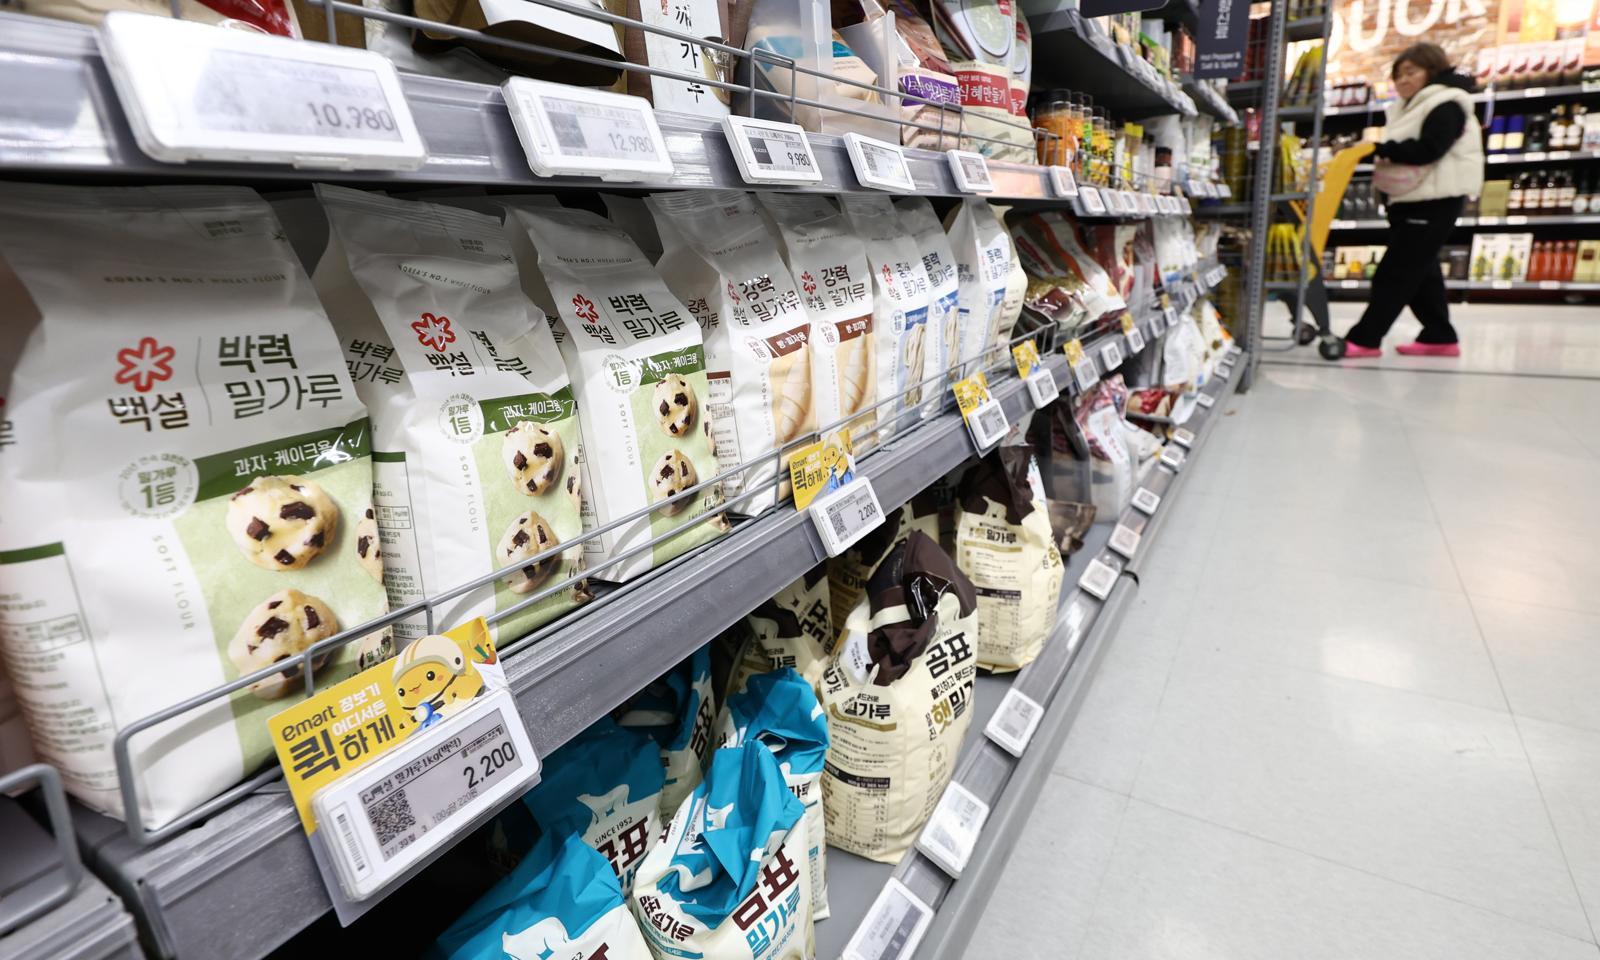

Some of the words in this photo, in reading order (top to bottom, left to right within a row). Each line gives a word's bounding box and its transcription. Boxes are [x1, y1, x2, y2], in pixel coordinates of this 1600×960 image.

[738, 275, 776, 302] 강력
[820, 264, 852, 287] 강력
[607, 293, 653, 316] 박력
[751, 290, 801, 322] 밀가루
[828, 283, 866, 307] 밀가루
[581, 323, 617, 345] 백설
[622, 310, 686, 340] 밀가루
[694, 312, 720, 330] 가루
[218, 333, 298, 373] 박력
[348, 338, 396, 364] 박력
[425, 350, 476, 377] 백설
[612, 372, 632, 387] 1등
[224, 373, 344, 419] 밀가루
[107, 391, 191, 433] 백설
[449, 416, 472, 436] 1등
[139, 481, 176, 509] 1등
[459, 455, 473, 487] SOFT
[468, 493, 481, 533] FLOUR
[151, 534, 178, 574] SOFT
[172, 580, 198, 632] FLOUR
[924, 631, 974, 681] 곰표
[281, 705, 337, 742] emart
[462, 740, 517, 789] 2,200
[594, 828, 617, 847] SINCE
[615, 815, 634, 834] 1952
[745, 884, 801, 960] 밀가루
